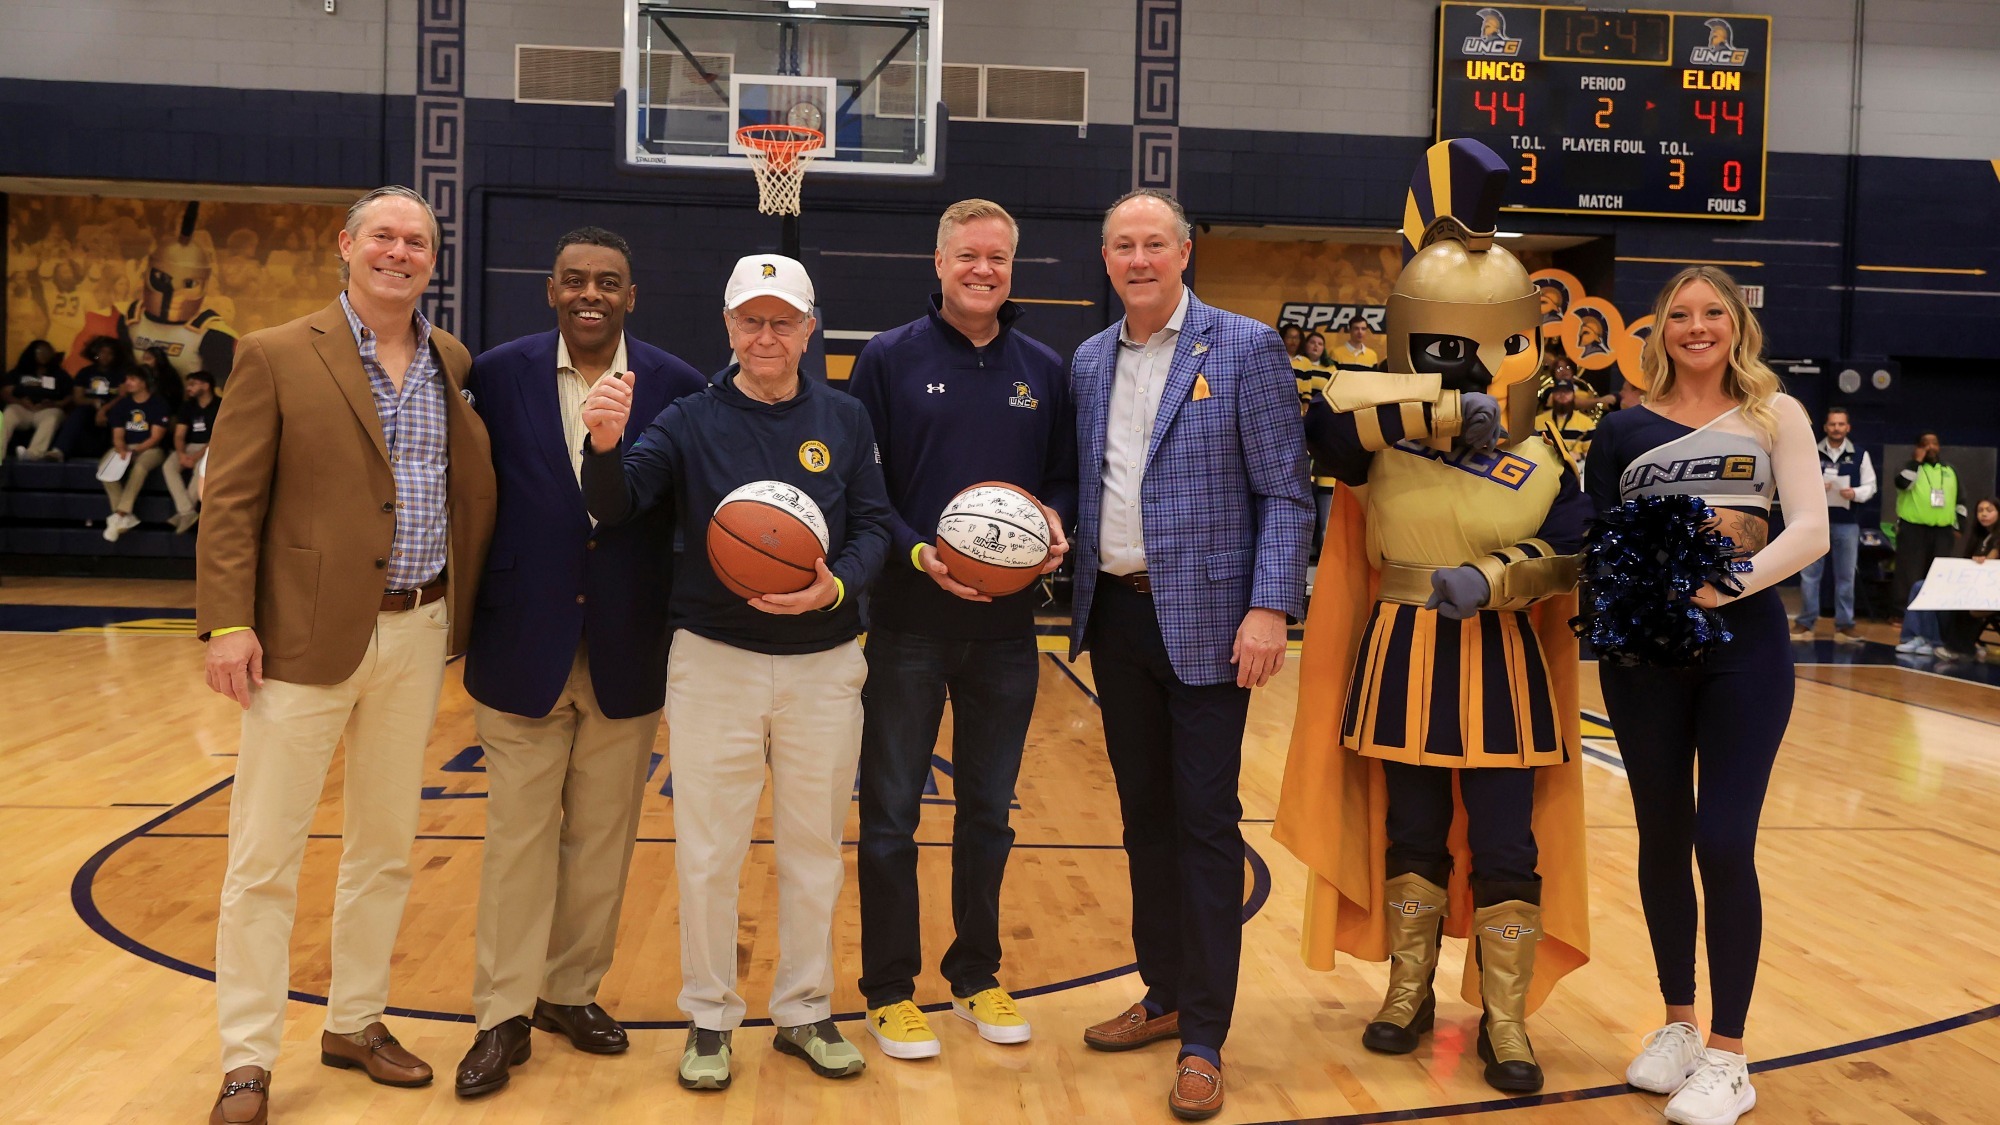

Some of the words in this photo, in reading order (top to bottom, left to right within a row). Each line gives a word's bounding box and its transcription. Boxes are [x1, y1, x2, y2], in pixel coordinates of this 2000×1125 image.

[1464, 38, 1519, 54] UNCG
[1692, 48, 1745, 64] UNCG
[1466, 60, 1525, 82] UNCG
[1580, 76, 1626, 91] PERIOD
[1683, 69, 1741, 91] ELON
[1475, 91, 1524, 127] 44
[1595, 97, 1613, 128] 2
[1694, 100, 1744, 135] 44
[1511, 136, 1545, 150] T.O.L.
[1562, 137, 1610, 153] PLAYER
[1614, 139, 1646, 154] FOUL
[1659, 141, 1694, 156] T.O.L.
[636, 156, 667, 164] SPALDING
[1520, 153, 1537, 184] 3
[1669, 158, 1685, 190] 3
[1723, 160, 1742, 192] 0
[1578, 194, 1623, 209] MATCH
[1707, 198, 1747, 213] FOULS
[1740, 287, 1761, 306] XIT
[1010, 396, 1038, 409] UNCG
[1621, 455, 1757, 495] UNCG
[973, 536, 1006, 553] UNCG
[1403, 901, 1419, 915] G
[1503, 926, 1520, 940] G
